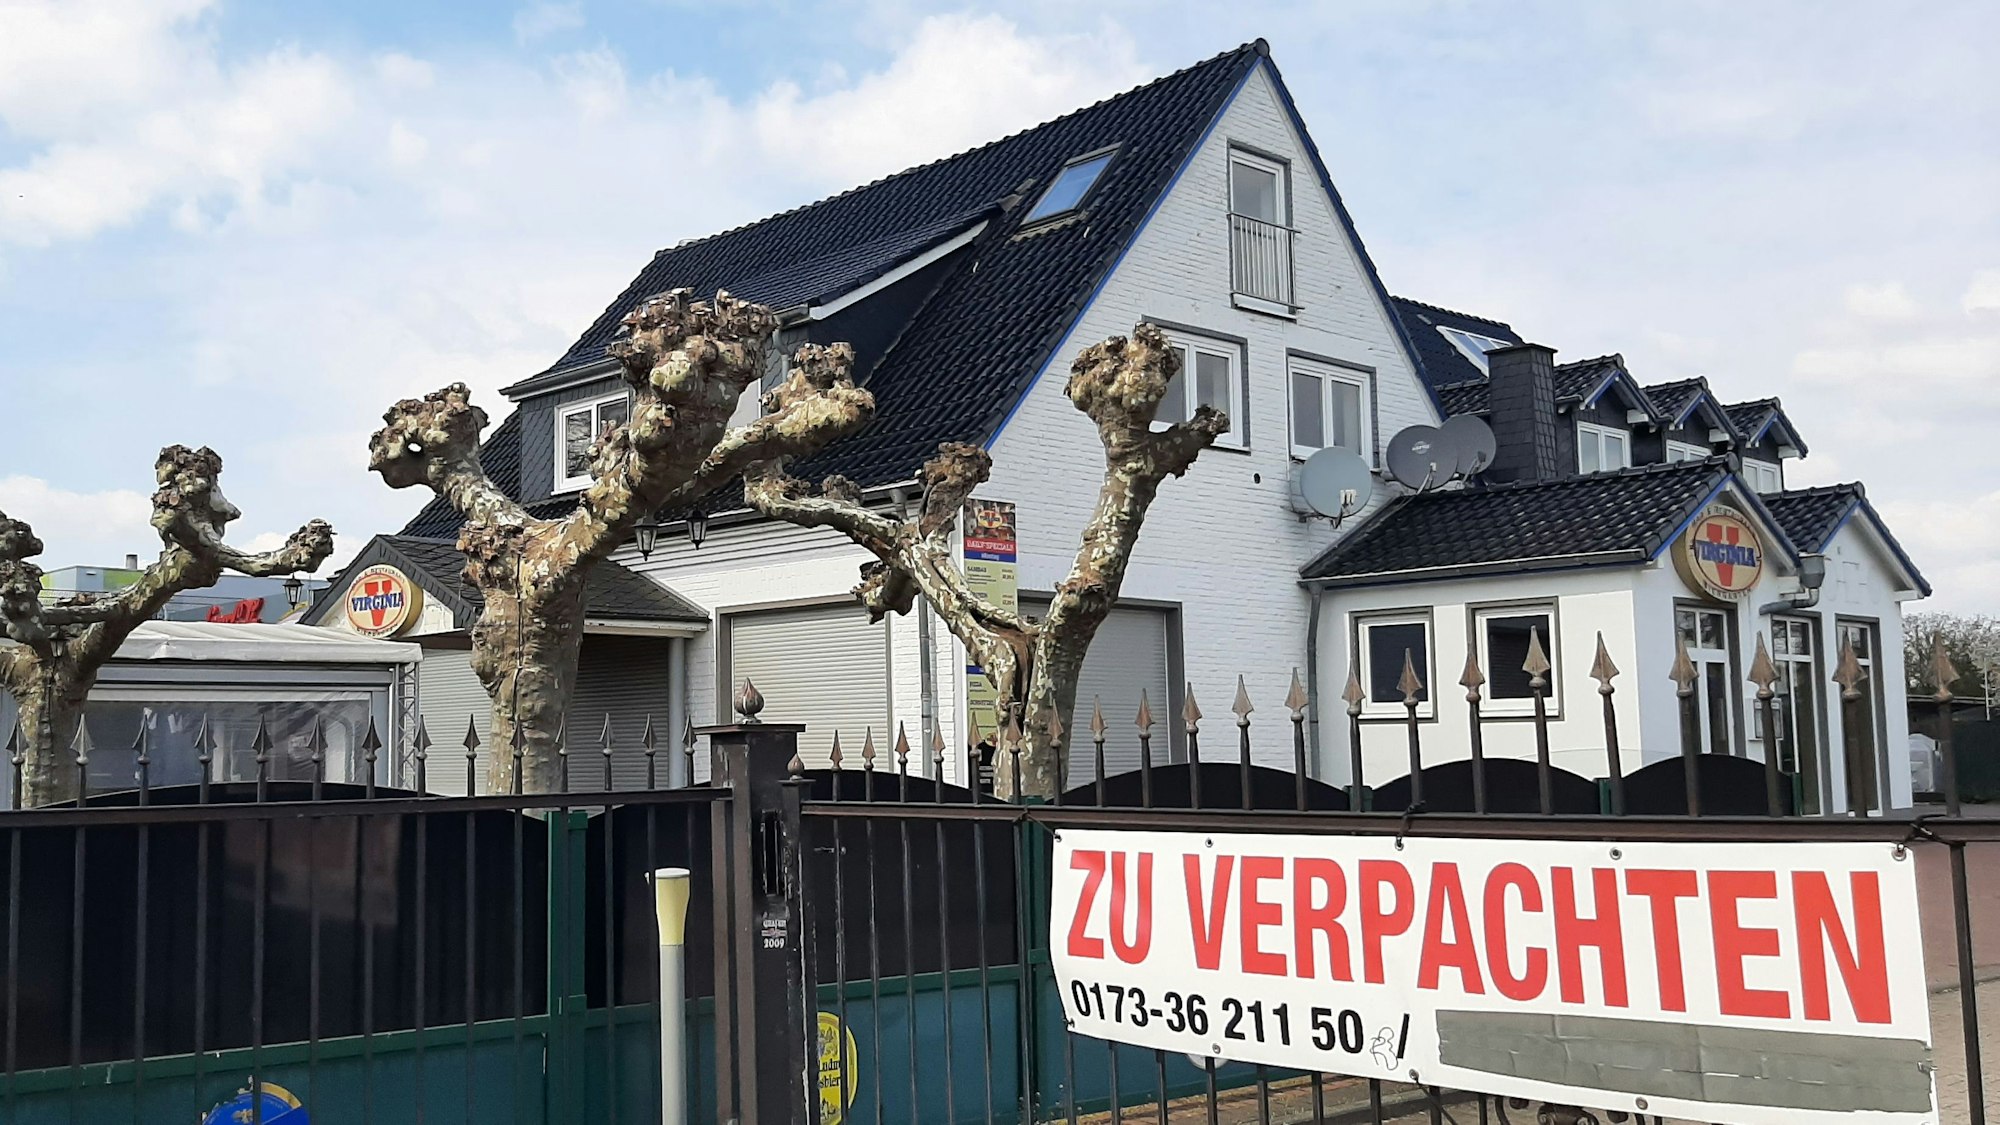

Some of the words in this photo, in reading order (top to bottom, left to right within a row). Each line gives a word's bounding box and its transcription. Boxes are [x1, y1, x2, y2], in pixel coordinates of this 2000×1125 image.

[1696, 540, 1756, 568] VIRGINIA
[352, 592, 404, 612] VIRGINIA
[763, 938, 785, 949] 2009
[1068, 850, 1153, 964] ZU
[1183, 852, 1892, 1025] VERPACHTEN
[1071, 979, 1209, 1036] 0173-36
[1221, 997, 1291, 1046] 211
[1311, 1006, 1364, 1054] 50
